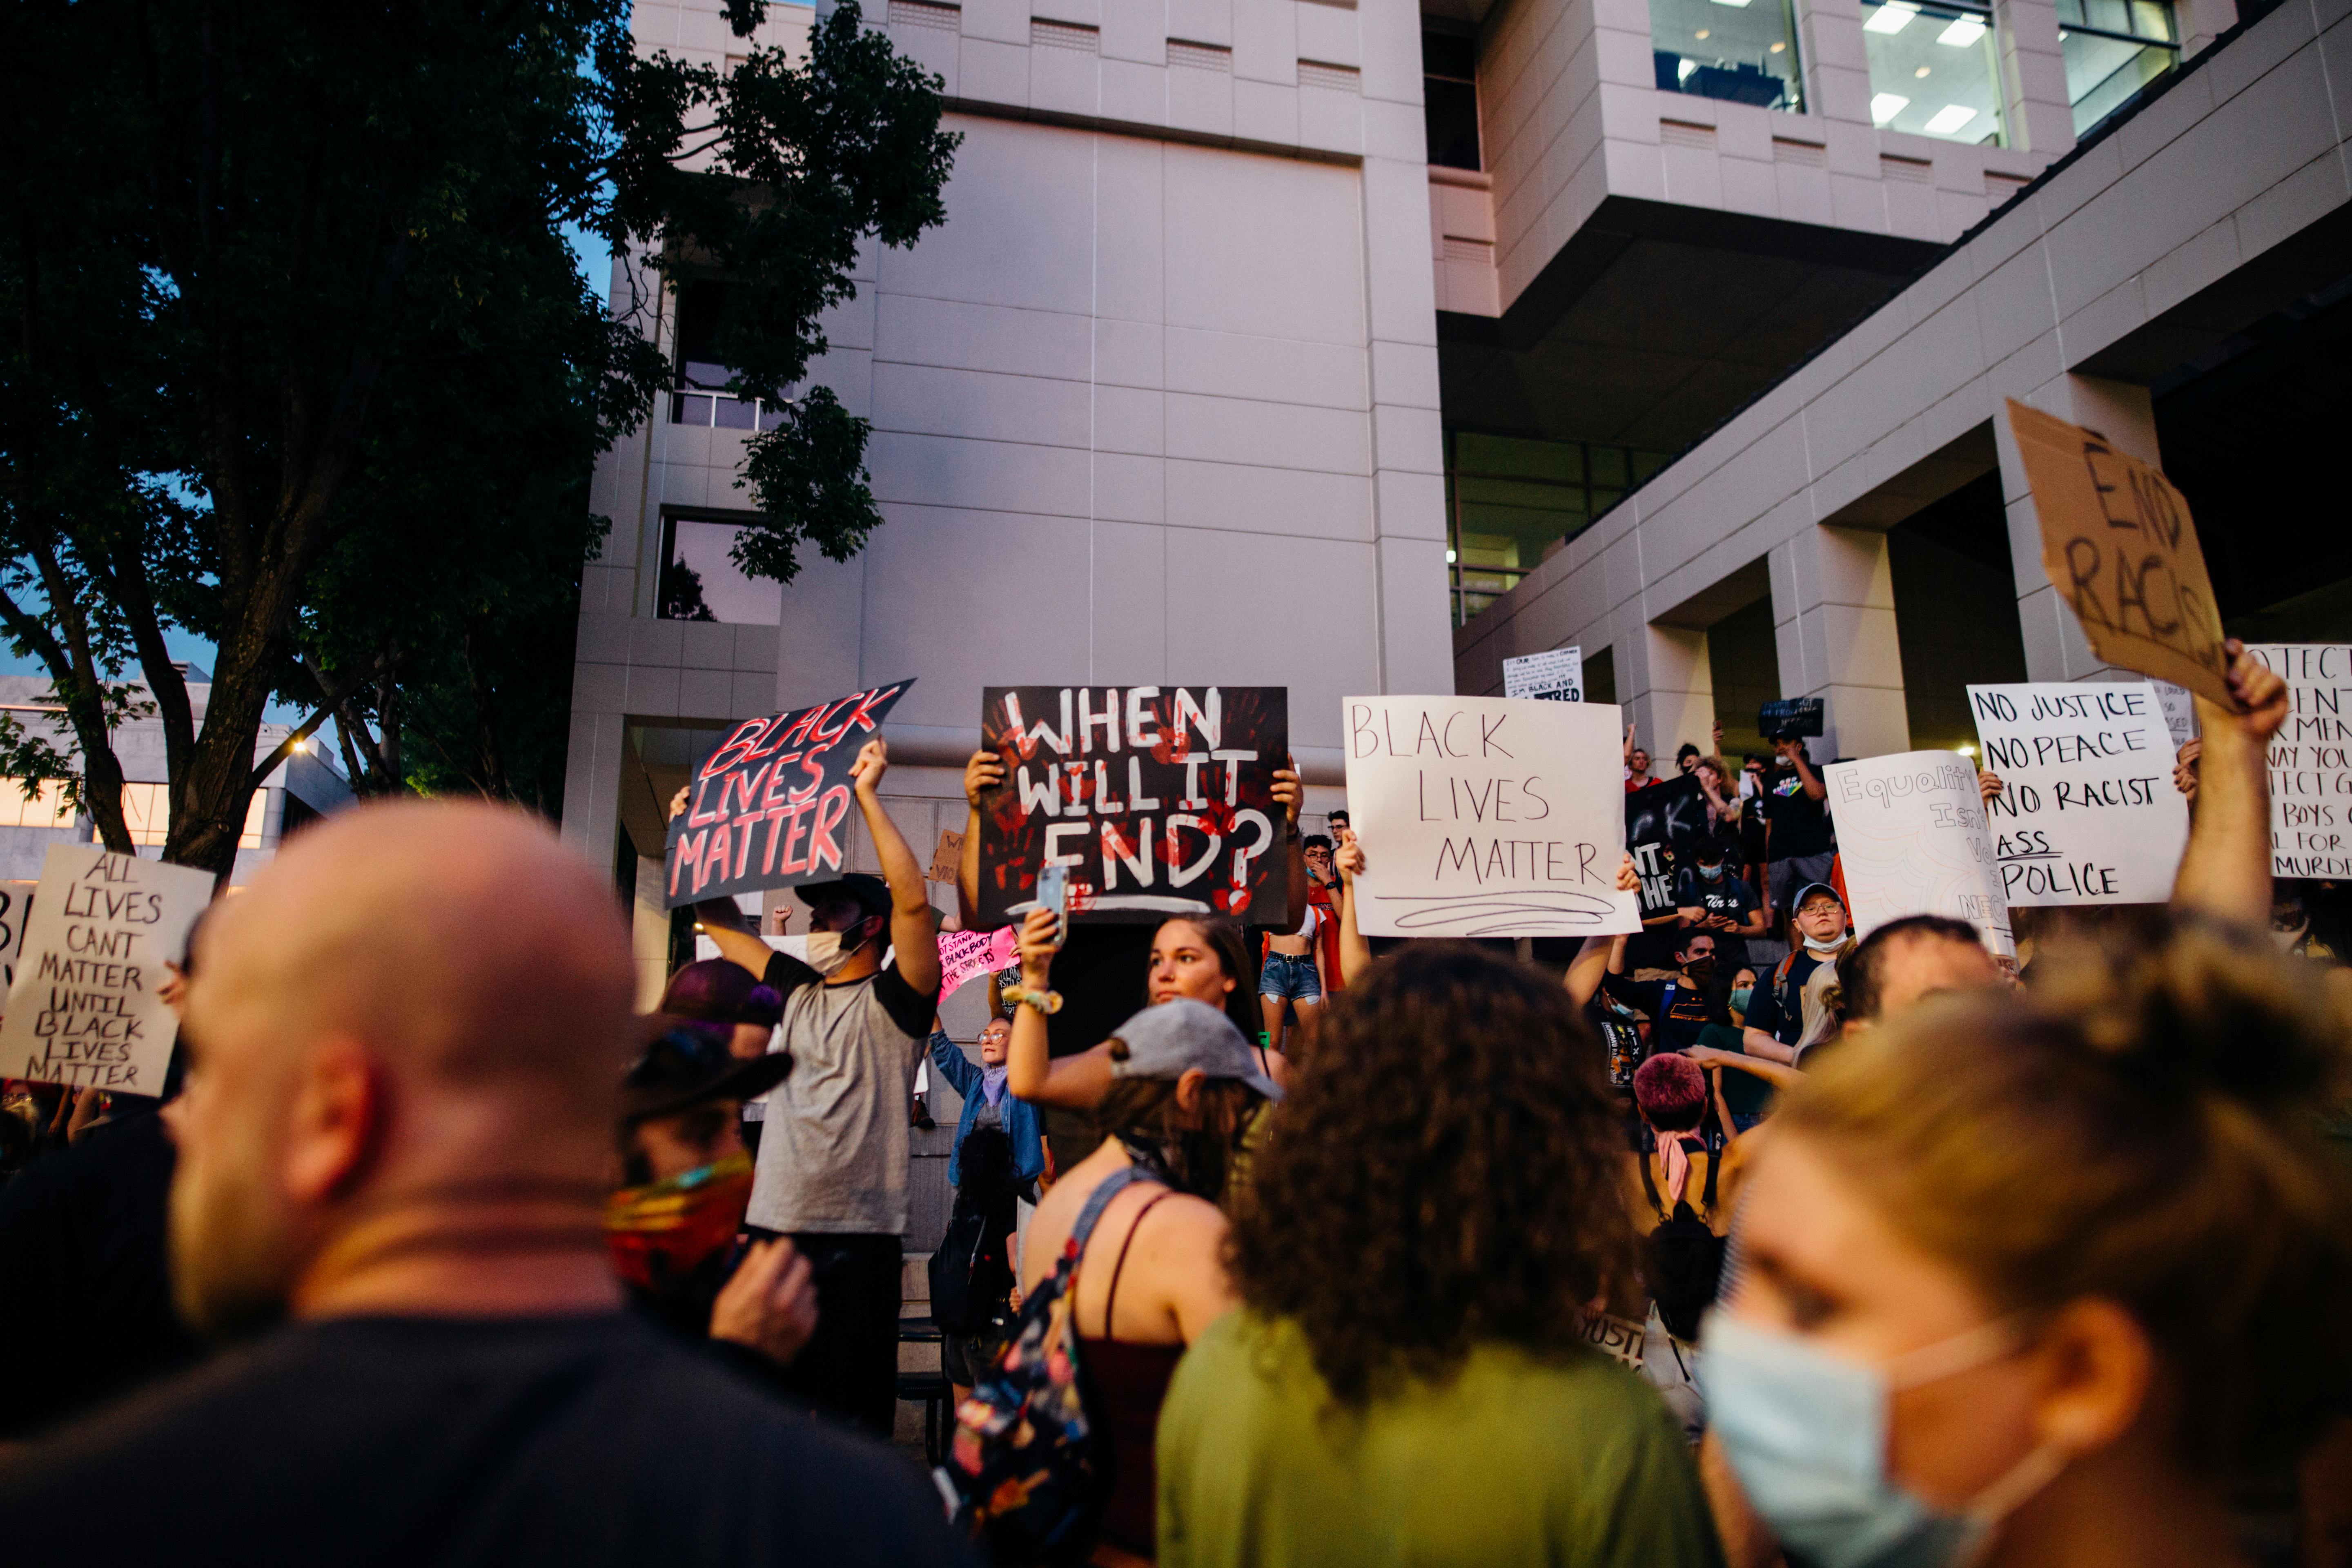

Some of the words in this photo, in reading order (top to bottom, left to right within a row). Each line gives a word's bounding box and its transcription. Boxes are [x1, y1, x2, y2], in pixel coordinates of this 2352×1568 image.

[2081, 441, 2181, 549] END
[1528, 683, 1552, 693] BLACK
[1556, 678, 1573, 688] AND
[1005, 686, 1222, 755] WHEN
[1974, 691, 2018, 722] NO
[2031, 692, 2147, 722] JUSTICE
[697, 685, 901, 782] BLACK
[1352, 704, 1515, 759] BLACK
[1986, 736, 2029, 771] NO
[2035, 729, 2148, 766] PEACE
[688, 742, 831, 829] LIVES
[1018, 756, 1160, 817] WILL
[1171, 749, 1258, 810] IT
[1419, 770, 1550, 824] LIVES
[1990, 782, 2041, 819] NO
[2053, 777, 2160, 811] RACIST
[2283, 803, 2334, 828] BOYS
[669, 784, 851, 898] MATTER
[1044, 808, 1273, 908] END?
[1436, 837, 1607, 885] MATTER
[1997, 831, 2050, 858] ASS
[2297, 831, 2347, 851] FOR
[84, 853, 140, 883] ALL
[1999, 862, 2120, 901] POLICE
[63, 882, 163, 924] LIVES
[942, 967, 959, 985] THE
[960, 948, 995, 974] STREETS
[945, 947, 969, 967] BLACK
[969, 931, 994, 954] BODY
[38, 951, 143, 991] MATTER
[50, 986, 136, 1018] UNTIL
[34, 1010, 144, 1040] BLACK
[45, 1037, 132, 1062] LIVES
[25, 1054, 140, 1087] MATTER
